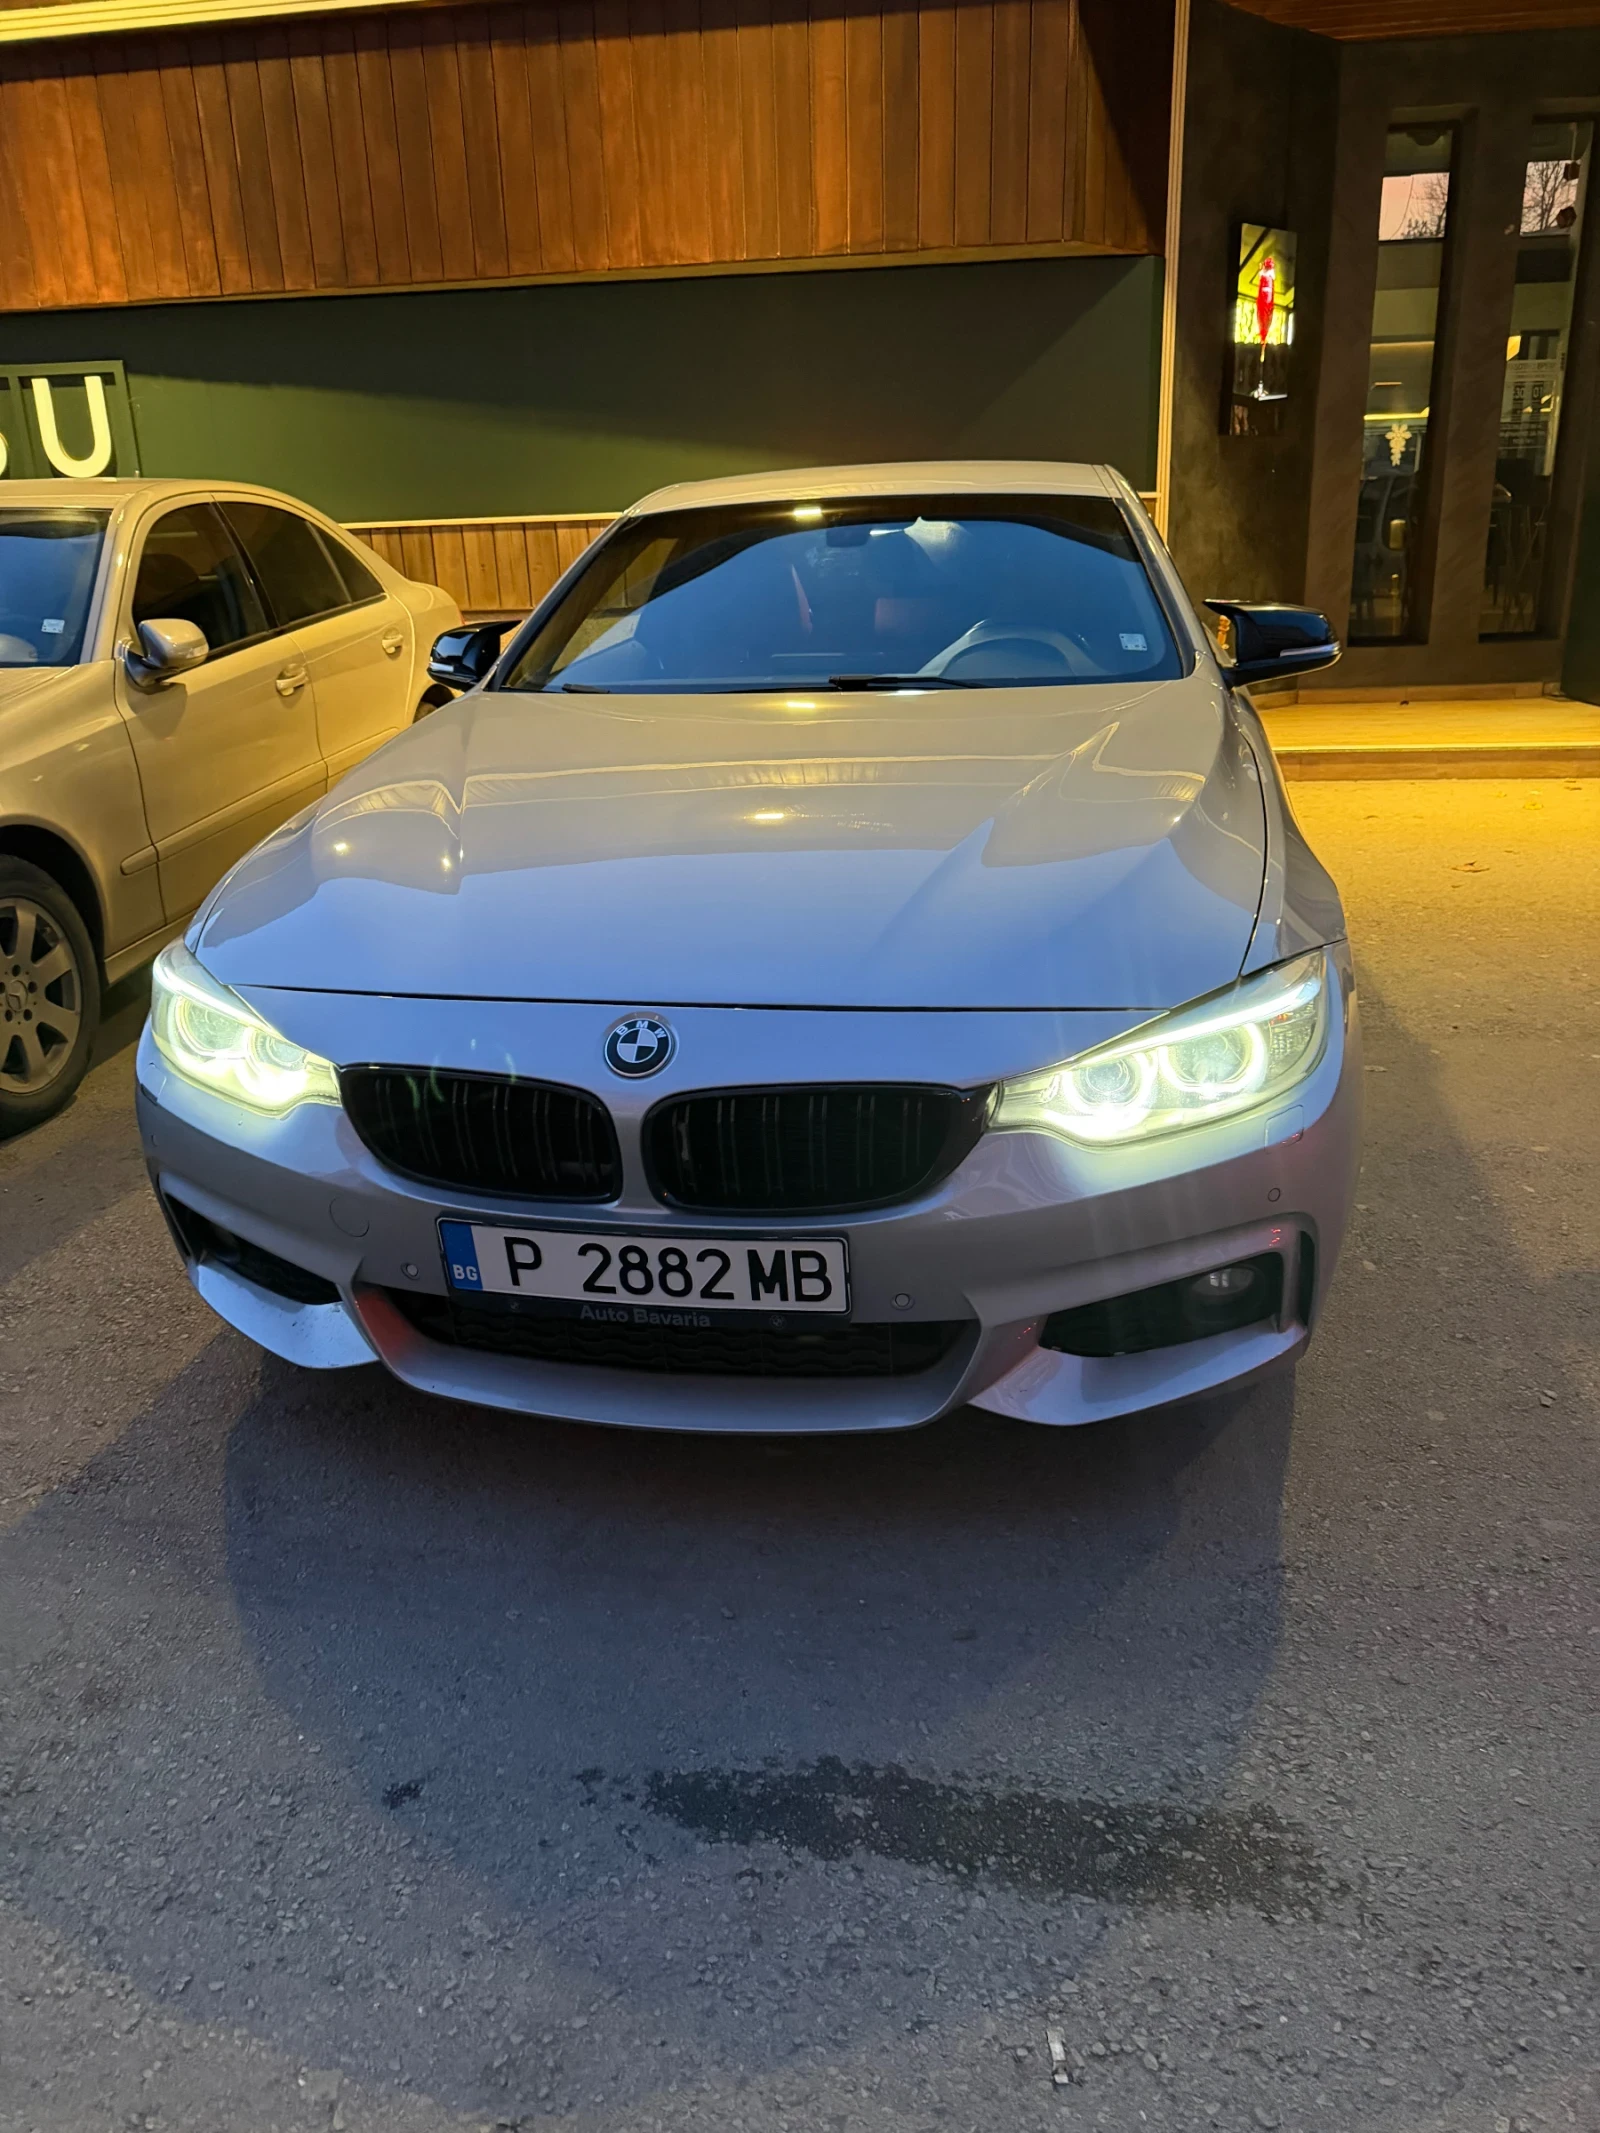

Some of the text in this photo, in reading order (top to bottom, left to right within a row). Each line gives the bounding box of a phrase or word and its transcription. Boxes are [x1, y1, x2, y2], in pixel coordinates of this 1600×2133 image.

[0, 376, 111, 478] U
[616, 1020, 667, 1039] BMW
[453, 1264, 478, 1281] BG
[504, 1236, 832, 1302] P 2882 MB
[580, 1305, 712, 1328] Auto Bavaria
